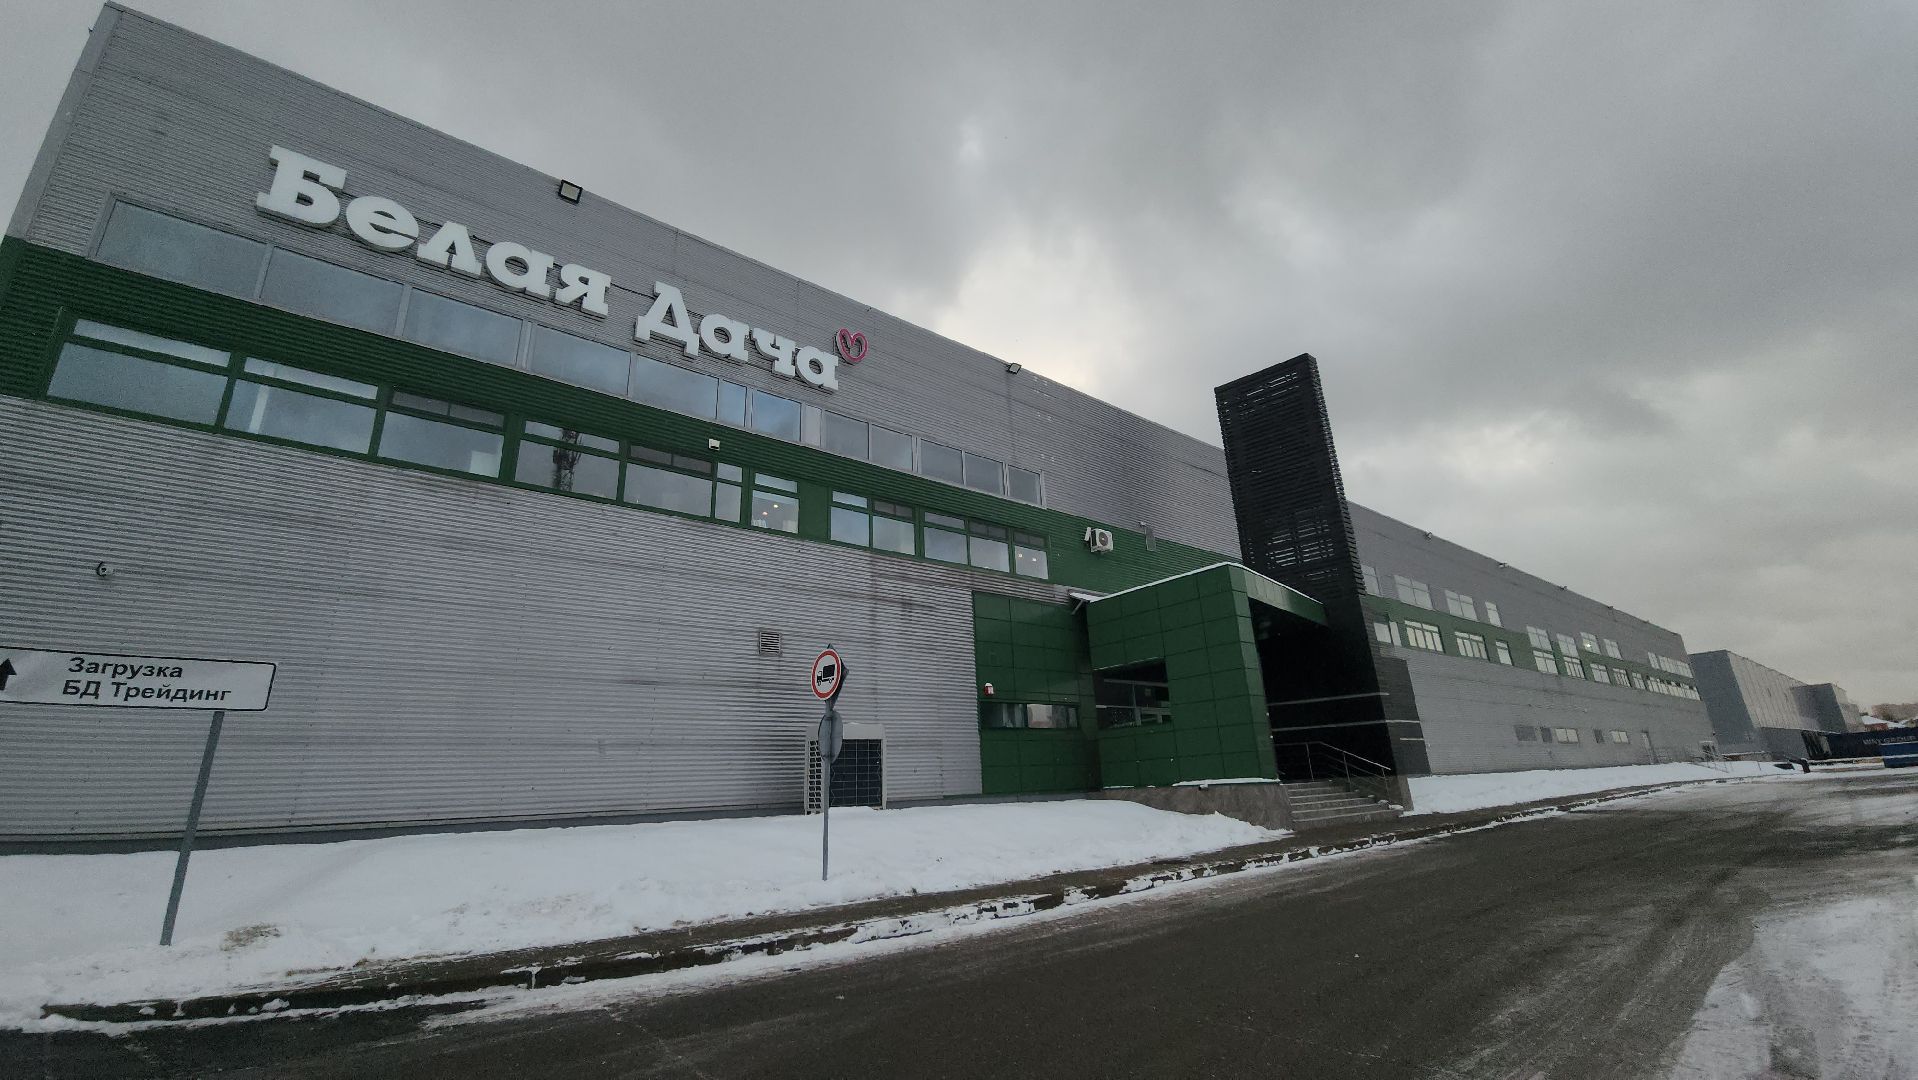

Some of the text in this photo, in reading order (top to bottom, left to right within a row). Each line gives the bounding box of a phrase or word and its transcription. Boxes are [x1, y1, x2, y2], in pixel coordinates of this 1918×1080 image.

[256, 145, 839, 392] Белая Дача
[68, 657, 183, 678] Загрузка
[62, 679, 231, 702] БД Трейдинг
